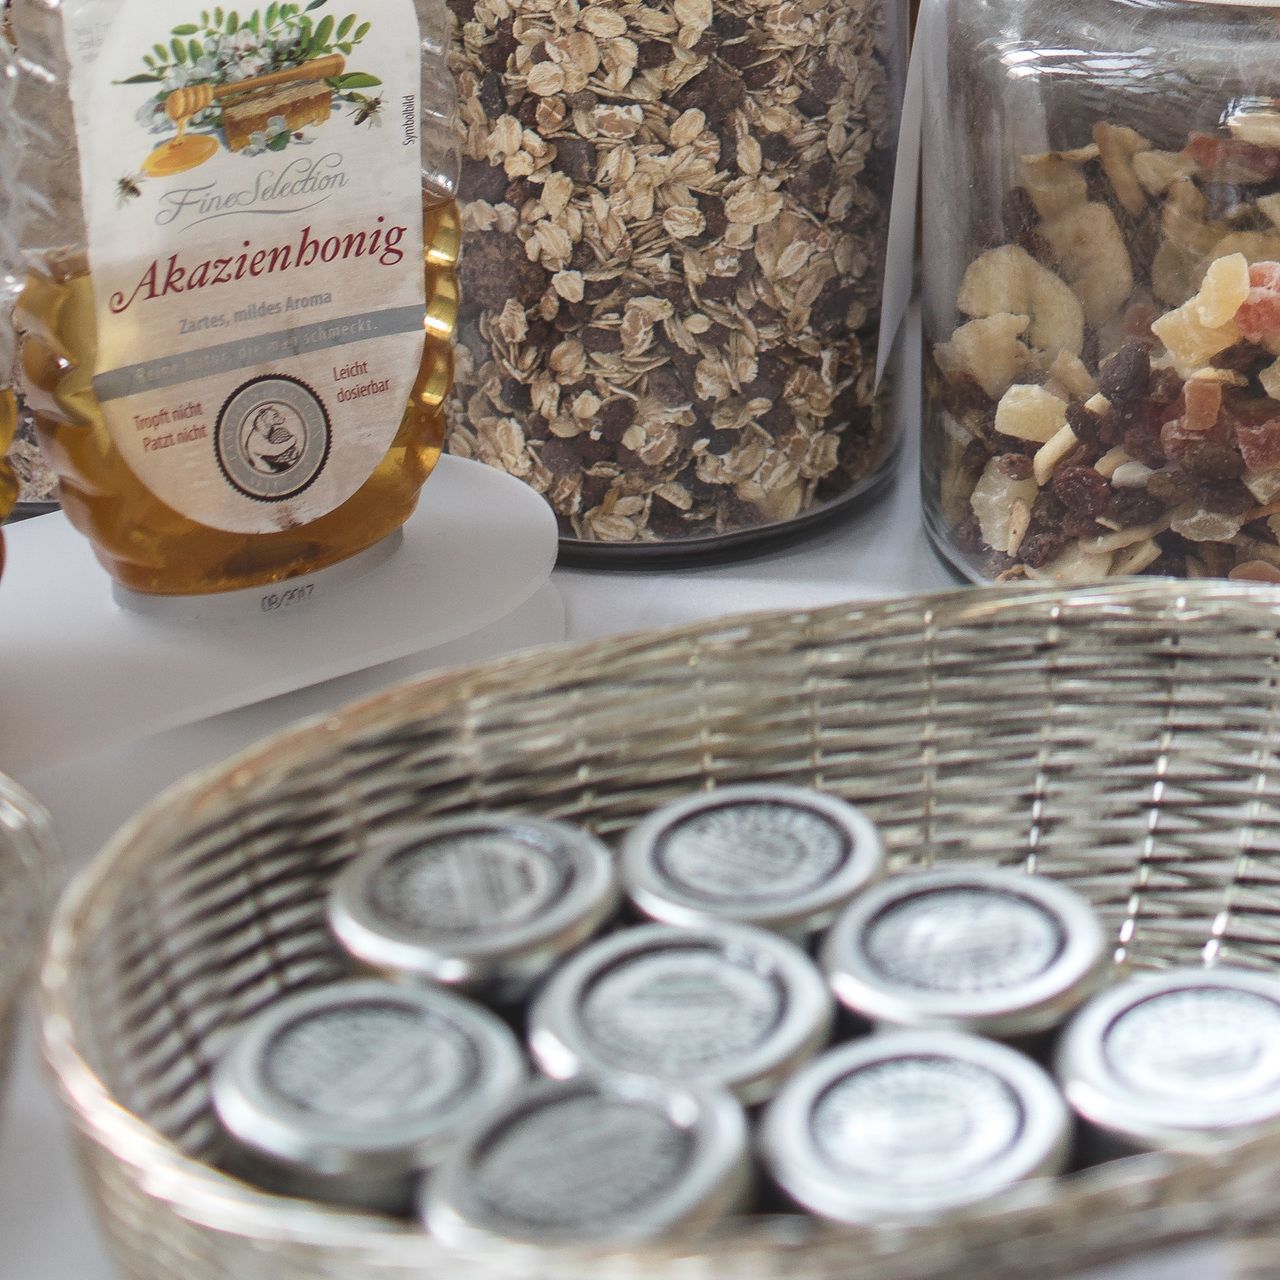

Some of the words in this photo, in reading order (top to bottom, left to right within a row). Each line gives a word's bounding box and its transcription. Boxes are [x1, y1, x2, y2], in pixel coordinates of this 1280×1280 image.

[402, 94, 417, 146] Symbolbild
[108, 215, 407, 314] Akazienhonig
[179, 315, 229, 335] Zartes,
[234, 302, 282, 323] mildes
[284, 291, 332, 312] Aroma
[332, 361, 368, 382] Leicht
[336, 377, 390, 404] dosierbar
[133, 408, 170, 431] Tropft
[172, 401, 202, 422] nicht
[177, 425, 208, 444] nicht
